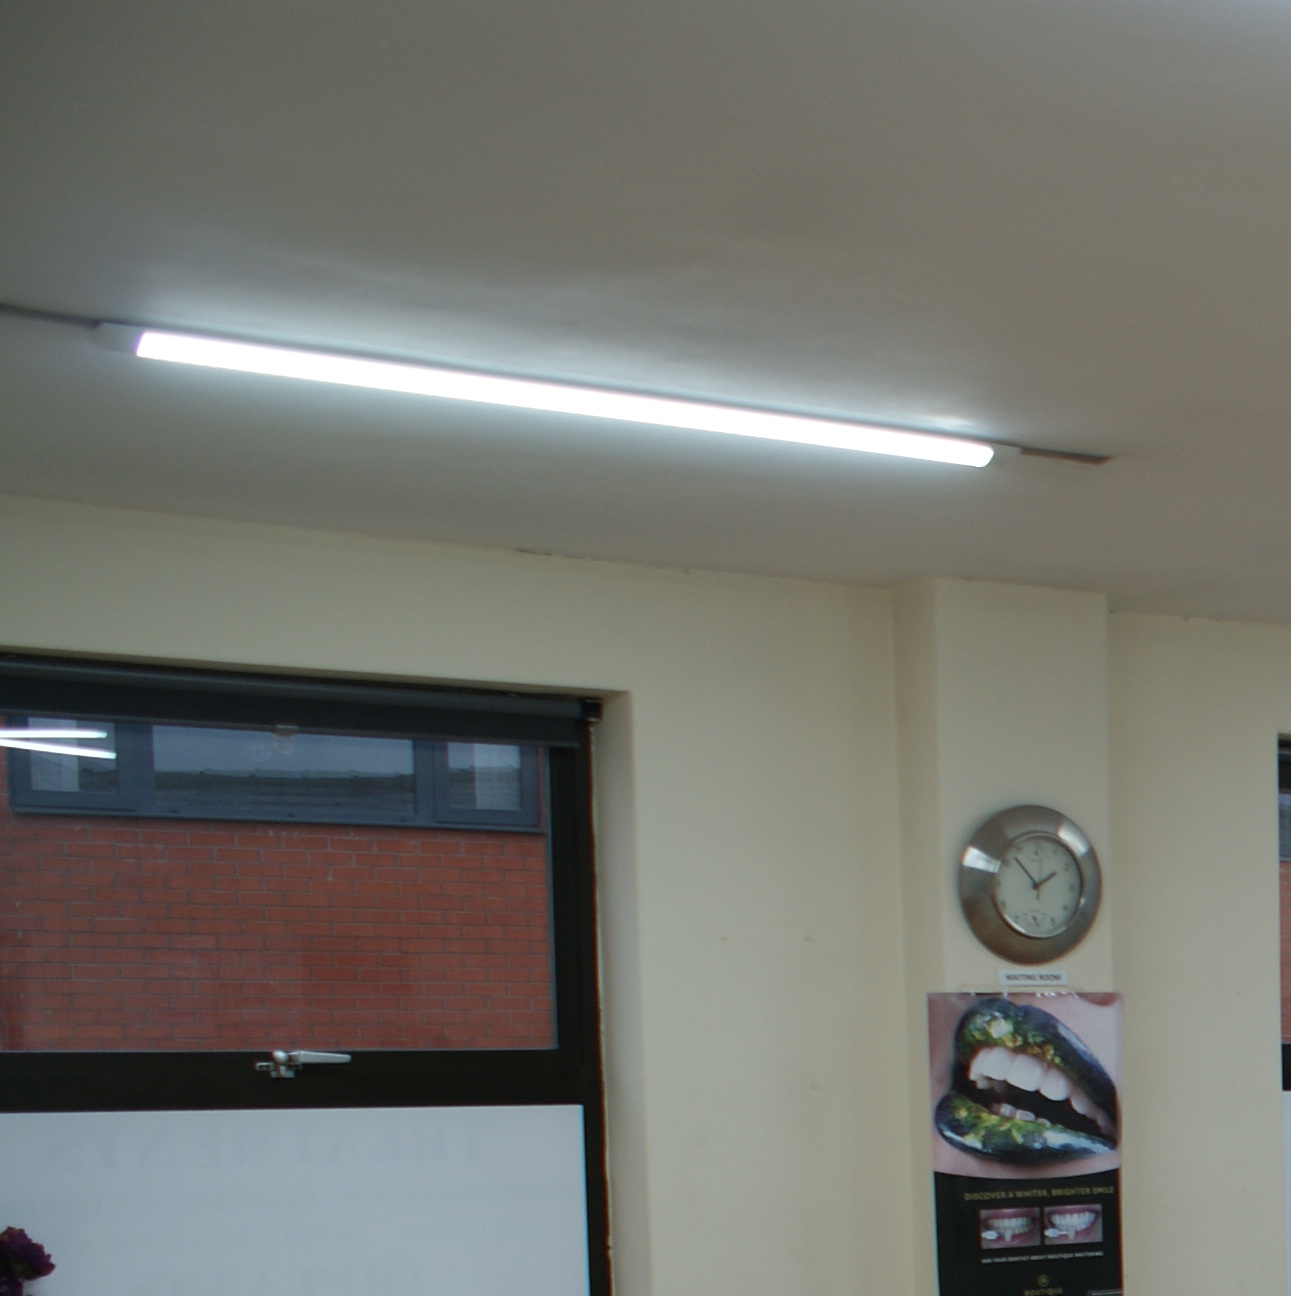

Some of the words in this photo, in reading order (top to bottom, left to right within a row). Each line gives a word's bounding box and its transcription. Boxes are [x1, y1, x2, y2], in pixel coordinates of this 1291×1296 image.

[964, 1192, 1006, 1200] DISCOVER
[1052, 1187, 1091, 1196] BRIGHTER
[1092, 1186, 1114, 1194] SMILE
[1024, 1288, 1063, 1296] BOUTIQUE
